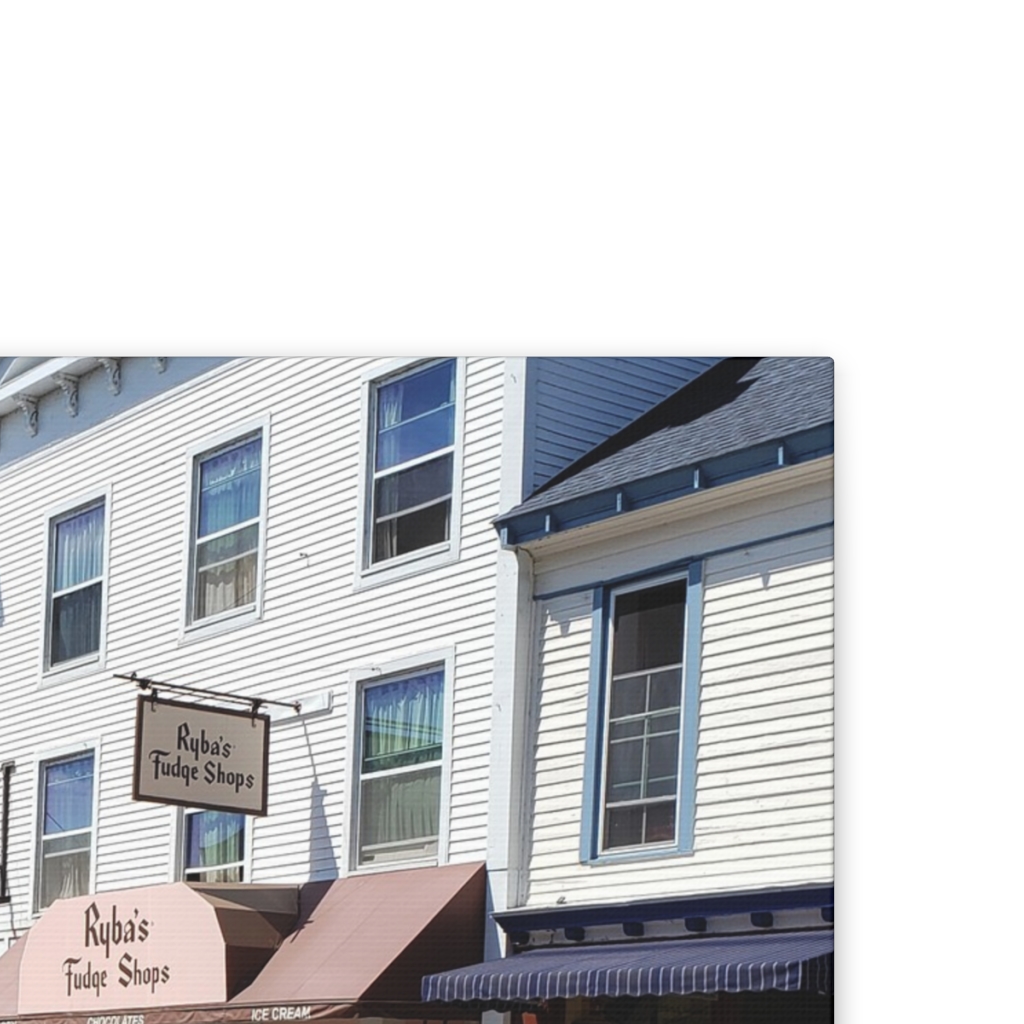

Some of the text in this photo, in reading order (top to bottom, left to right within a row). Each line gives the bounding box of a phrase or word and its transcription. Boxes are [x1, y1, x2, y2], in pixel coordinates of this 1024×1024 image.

[177, 722, 232, 761] Ryba's
[148, 749, 255, 793] Fudge Shops
[84, 901, 150, 959] Ryba's
[62, 952, 170, 997] Fudge Shops
[251, 1006, 311, 1021] ICE CREAM
